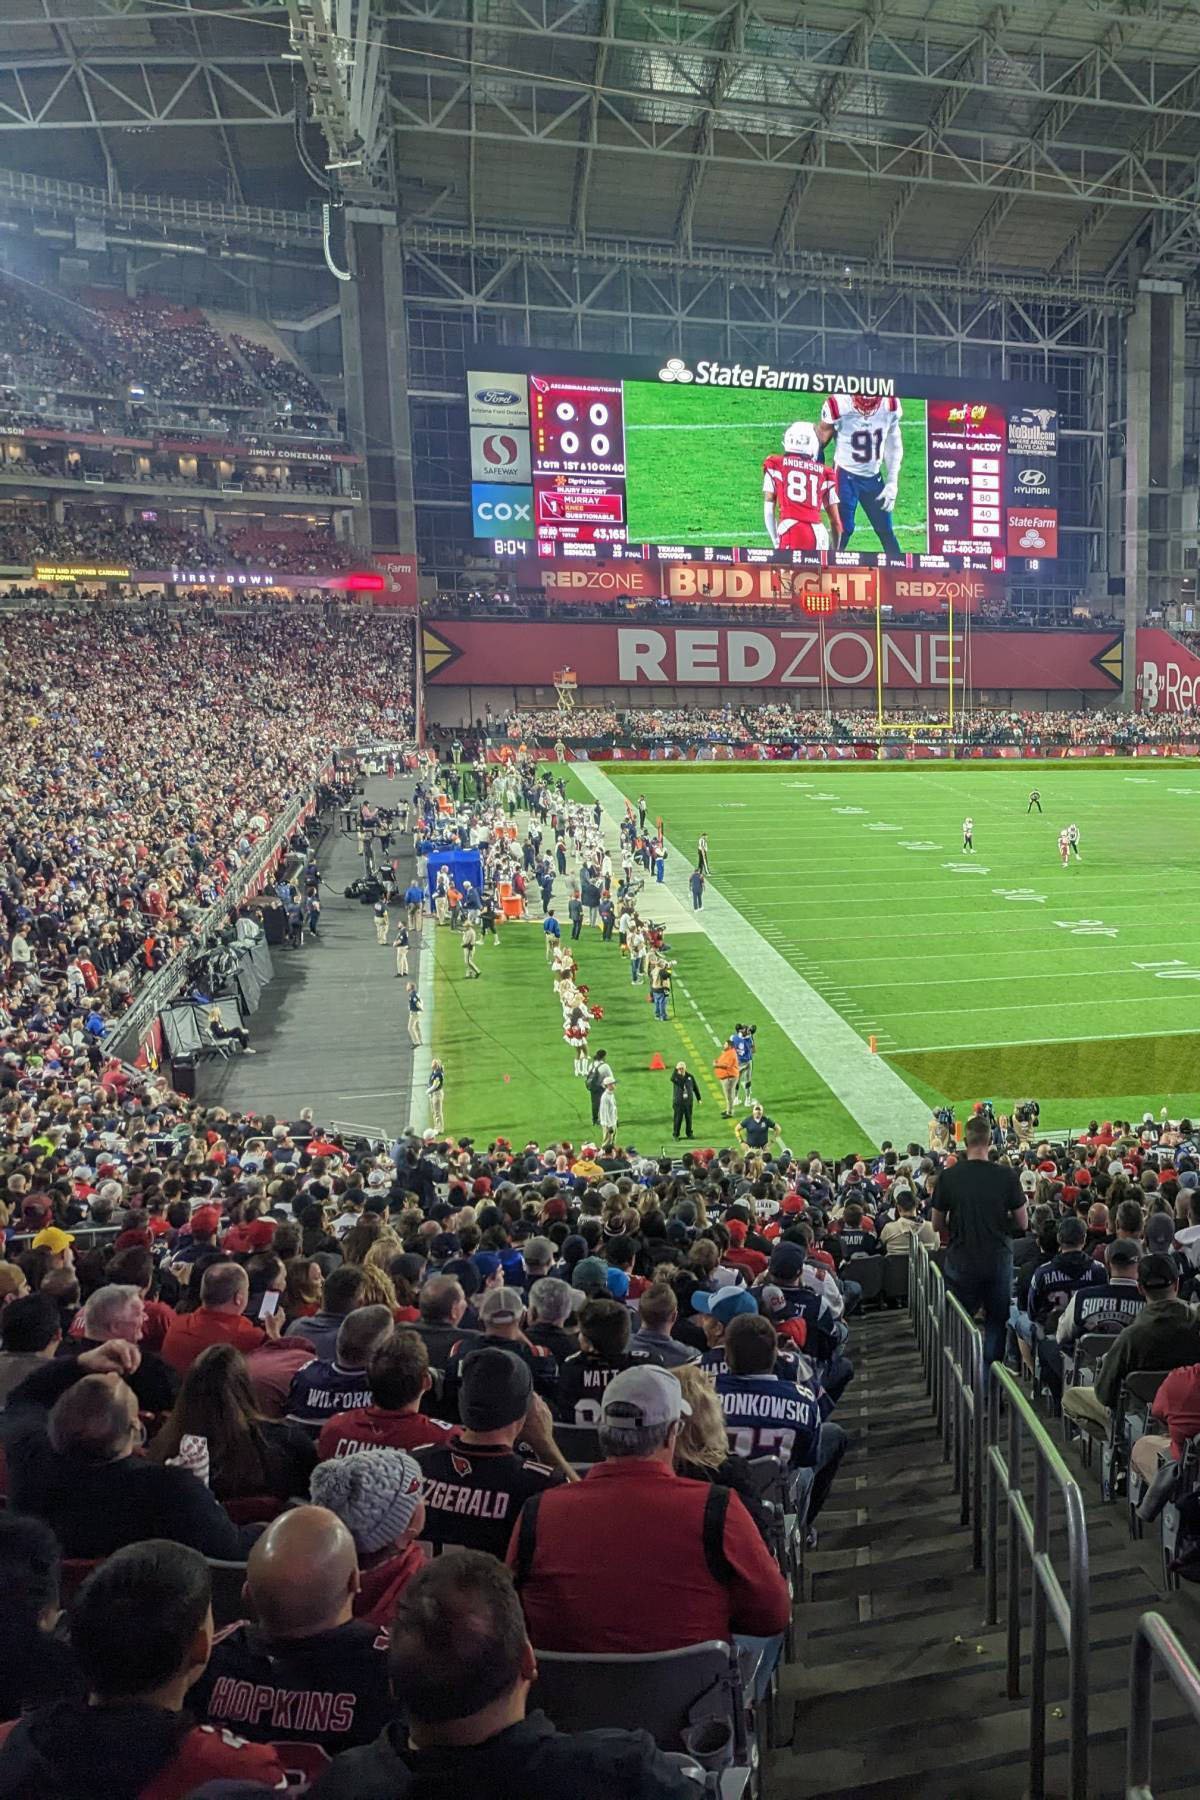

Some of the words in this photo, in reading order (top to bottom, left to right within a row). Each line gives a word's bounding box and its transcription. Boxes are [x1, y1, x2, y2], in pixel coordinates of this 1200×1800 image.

[812, 373, 895, 396] STADIUM
[484, 390, 512, 404] Ford
[589, 403, 608, 426] 0
[0, 426, 25, 435] ILSON
[560, 431, 579, 454] 0
[590, 433, 609, 456] 0
[851, 428, 882, 463] 91
[247, 449, 276, 457] JIMMY
[278, 451, 332, 461] CONZELMAN
[484, 467, 518, 475] SAFEWAY
[563, 461, 579, 470] 1ST
[587, 461, 598, 470] 10
[612, 463, 624, 471] 40
[783, 457, 824, 473] ANDERSON
[933, 460, 956, 468] COMP
[787, 470, 818, 507] 81
[933, 477, 970, 485] ATTEMPTS
[934, 492, 956, 500] COMP
[1014, 486, 1050, 495] HYUNDAI
[564, 496, 600, 504] MURRAY
[478, 502, 530, 521] COX
[934, 508, 959, 516] YARDS
[593, 528, 625, 539] 43,165
[934, 524, 949, 532] TDS
[494, 540, 526, 554] 8:04
[173, 573, 216, 583] FIRST
[227, 575, 273, 584] DOWN
[669, 568, 753, 599] BUD
[617, 628, 964, 685] REDZONE
[991, 888, 1048, 903] 30
[1052, 919, 1119, 938] 20
[1081, 1298, 1117, 1319] SUPER
[1120, 1298, 1147, 1314] BOW
[307, 1388, 374, 1408] WILFORK
[715, 1392, 809, 1425] RONKOWSKI
[423, 1478, 510, 1519] ZGERALD
[208, 1676, 357, 1732] HOPKINS
